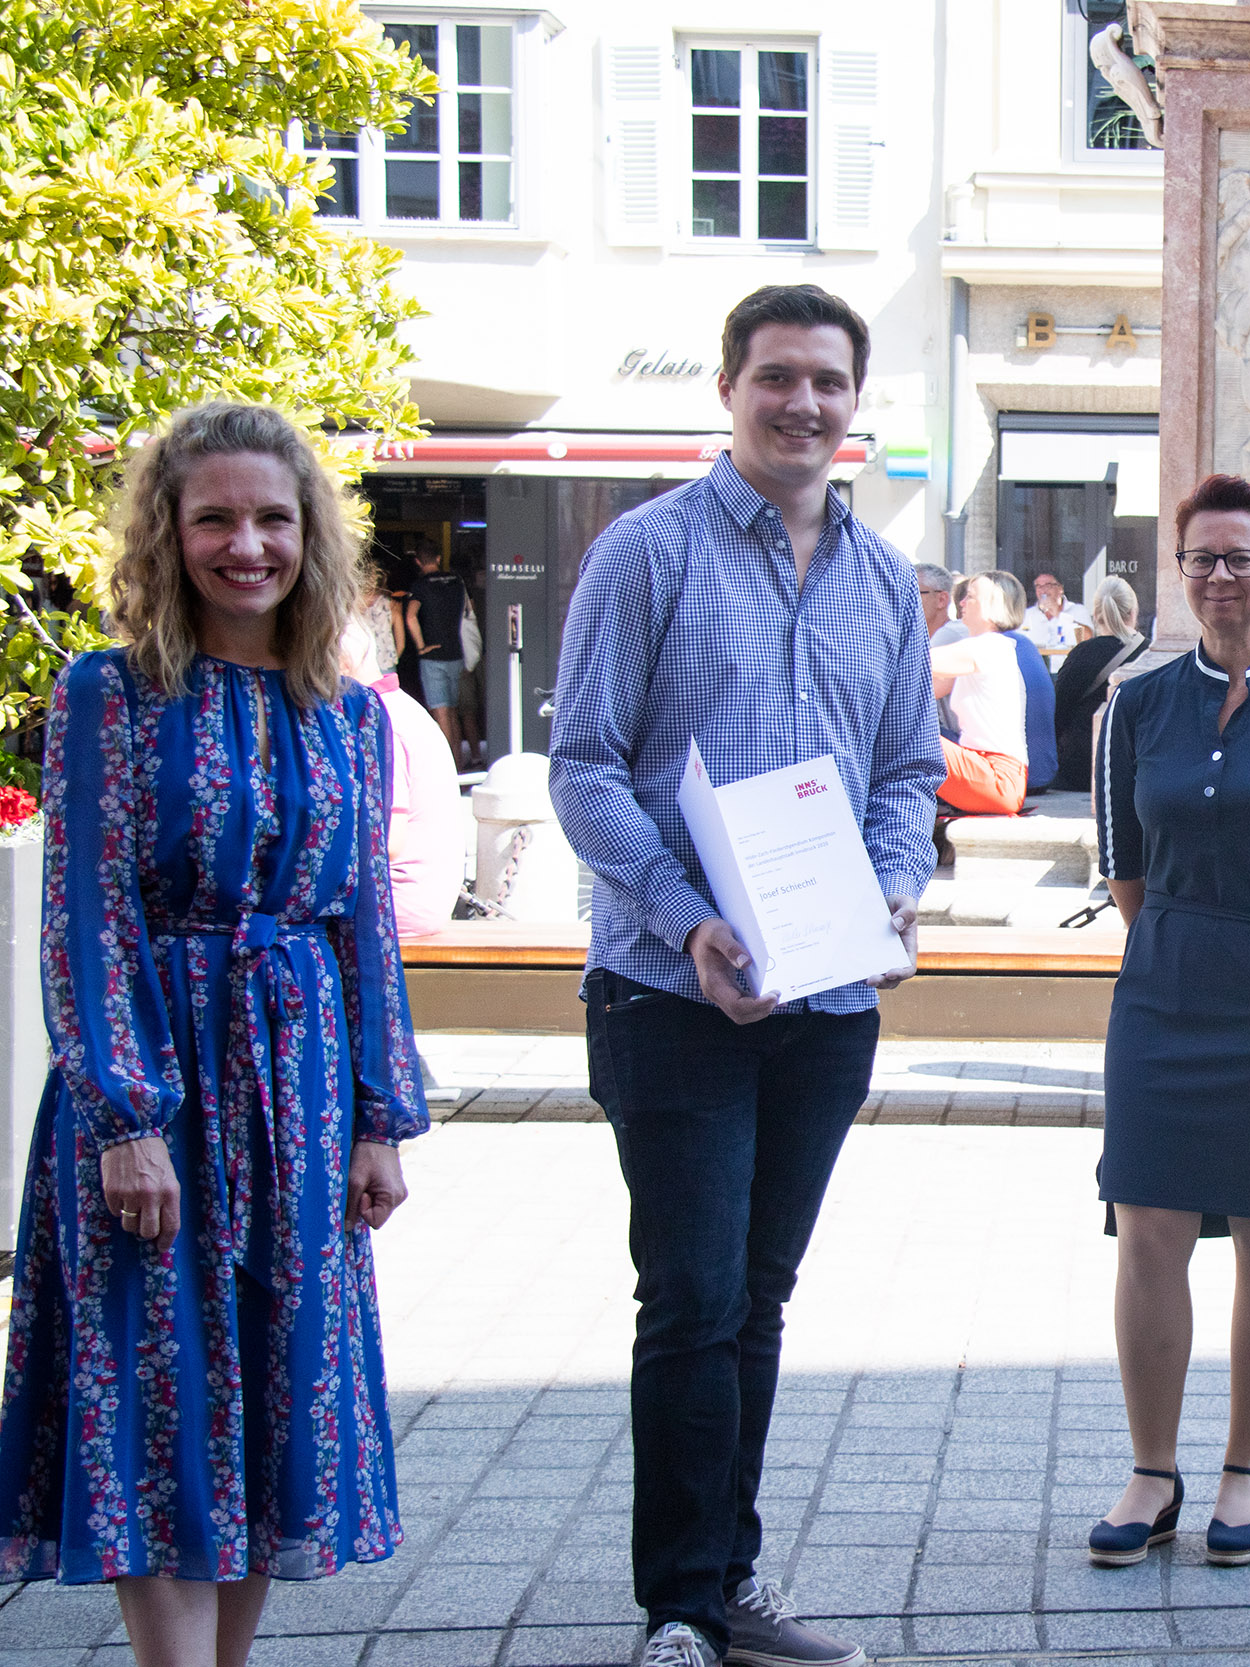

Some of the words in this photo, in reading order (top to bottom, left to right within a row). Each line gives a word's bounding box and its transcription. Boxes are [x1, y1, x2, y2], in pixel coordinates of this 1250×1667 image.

[617, 348, 705, 376] Gelato
[490, 563, 545, 573] TOMASELLI
[1109, 560, 1127, 574] BAR
[796, 783, 829, 800] BRUCK
[759, 887, 780, 902] Josef
[780, 876, 818, 895] Schiechtl
